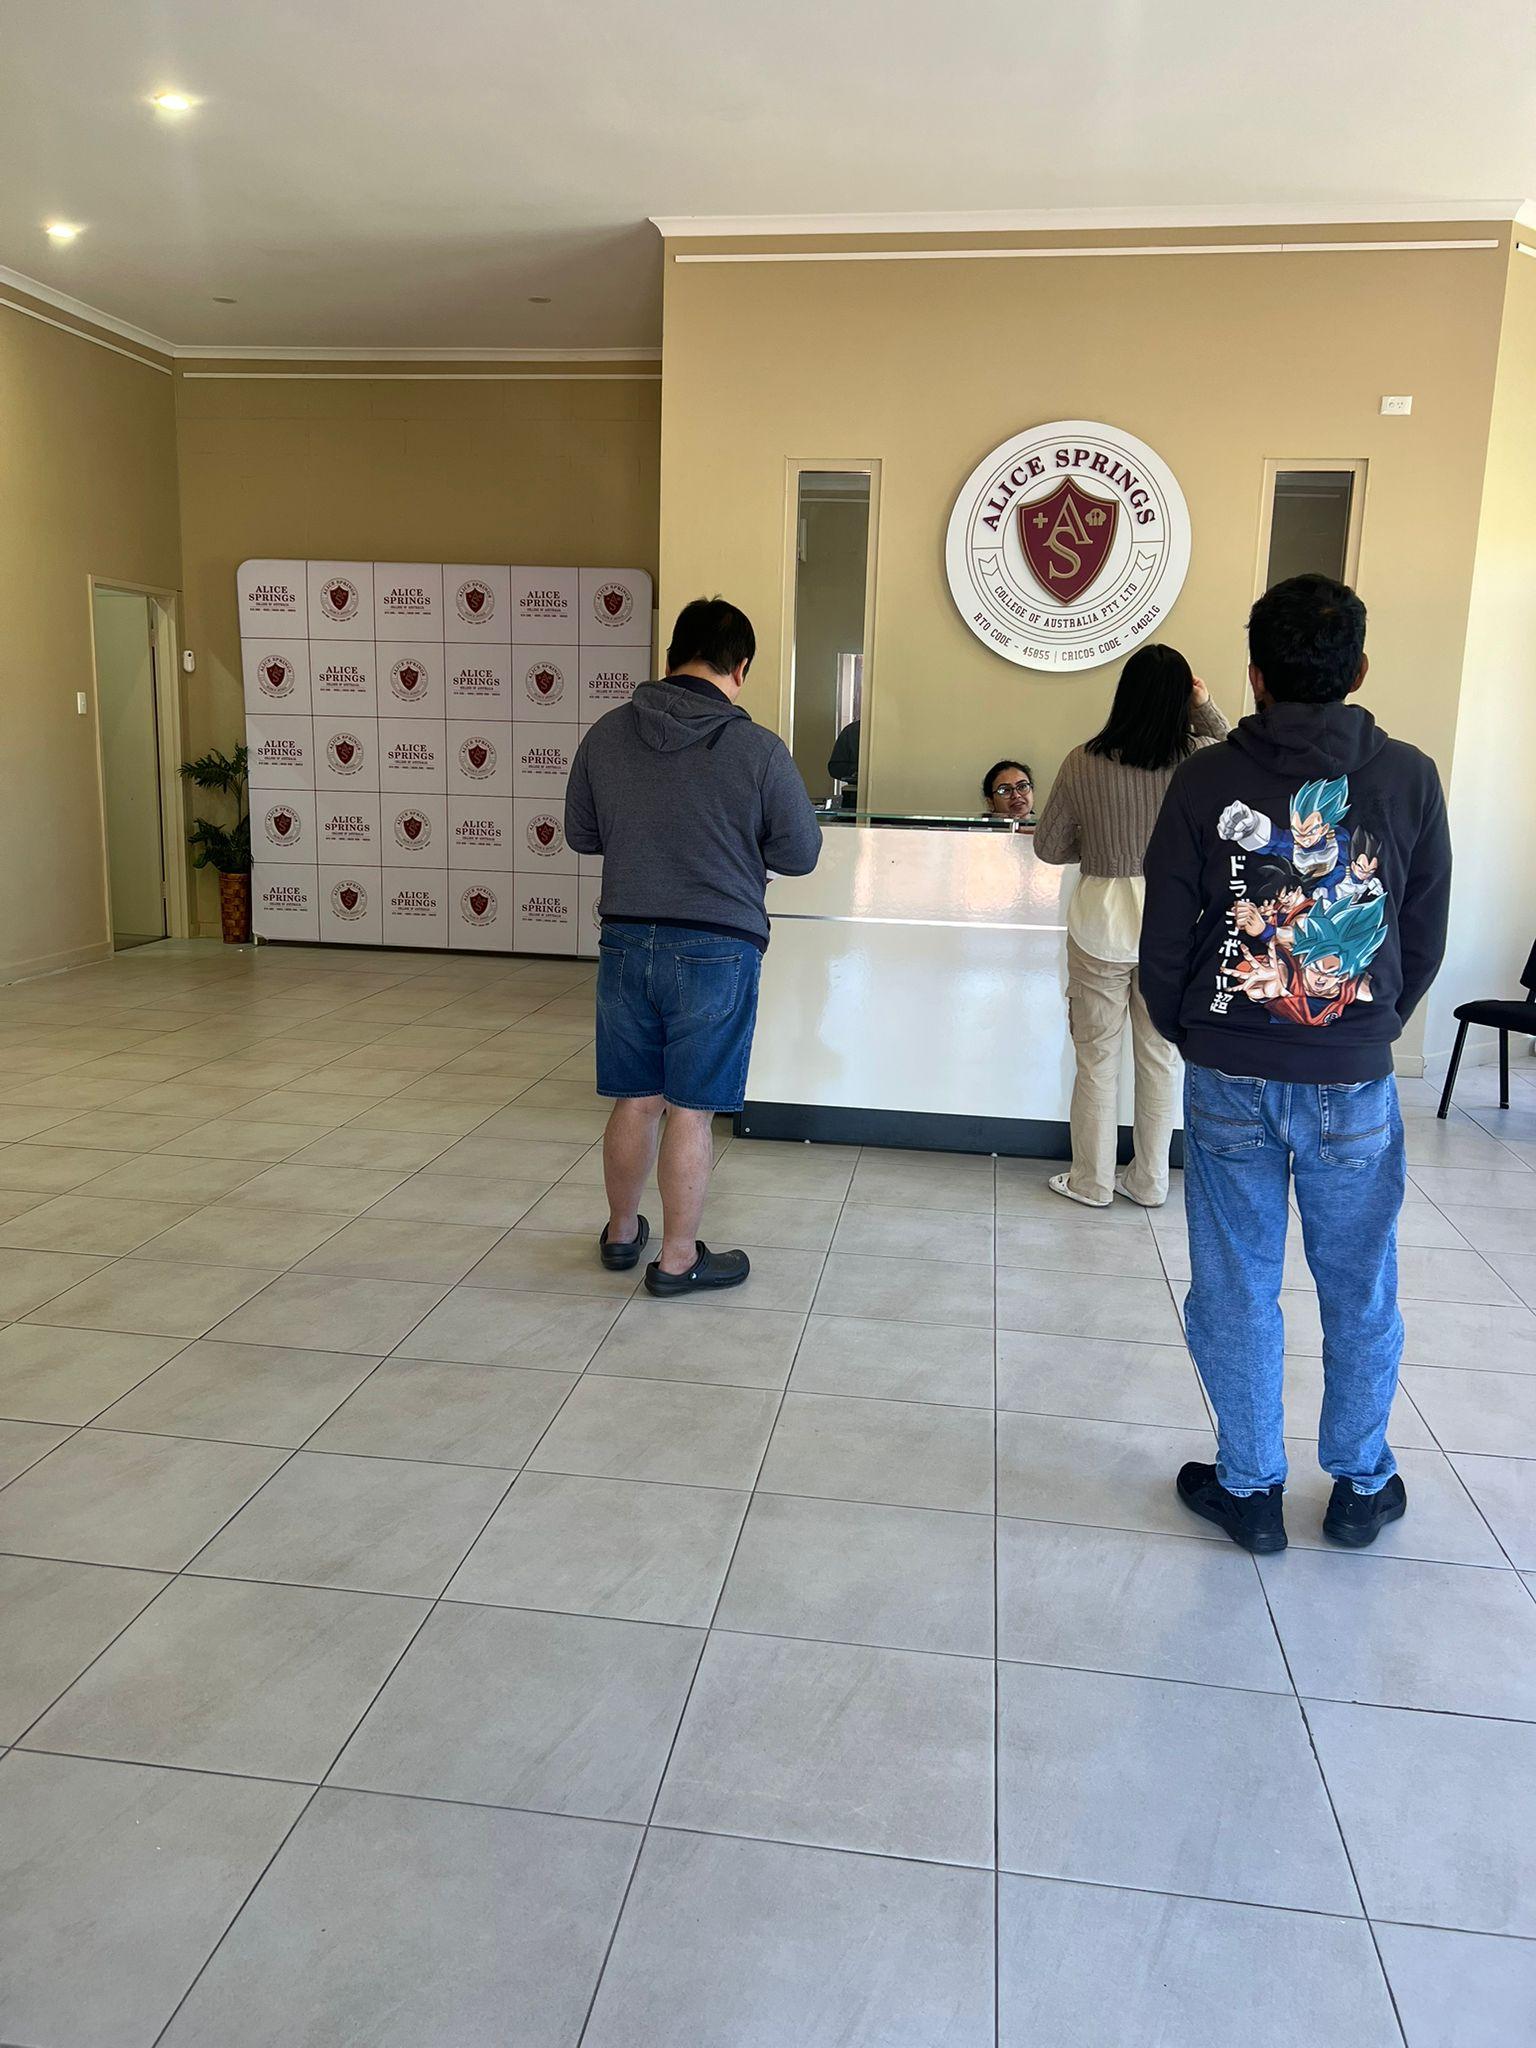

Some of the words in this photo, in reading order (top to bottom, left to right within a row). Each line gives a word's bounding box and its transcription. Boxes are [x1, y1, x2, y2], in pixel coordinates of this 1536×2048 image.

[983, 456, 1045, 531] ALICE
[1055, 449, 1155, 525] SPRINGS
[520, 599, 568, 607] SPRINGS
[994, 586, 1026, 618] COLLEGE
[1028, 613, 1040, 622] OF
[1044, 613, 1099, 628] AUSTRALIA
[1101, 600, 1120, 617] PTY
[1120, 582, 1137, 603] LTD
[974, 612, 990, 631] RTO
[991, 629, 1012, 648] CODE
[1023, 647, 1050, 660] 45855
[1061, 648, 1095, 661] CRICOS
[1098, 637, 1121, 654] CODE
[319, 674, 365, 682] SPRINGS
[589, 681, 636, 689] SPRINGS
[258, 748, 302, 756] SPRINGS
[388, 752, 434, 760] SPRINGS
[522, 756, 568, 765] SPRINGS
[391, 899, 436, 907] SPRINGS
[522, 905, 568, 914] SPRINGS
